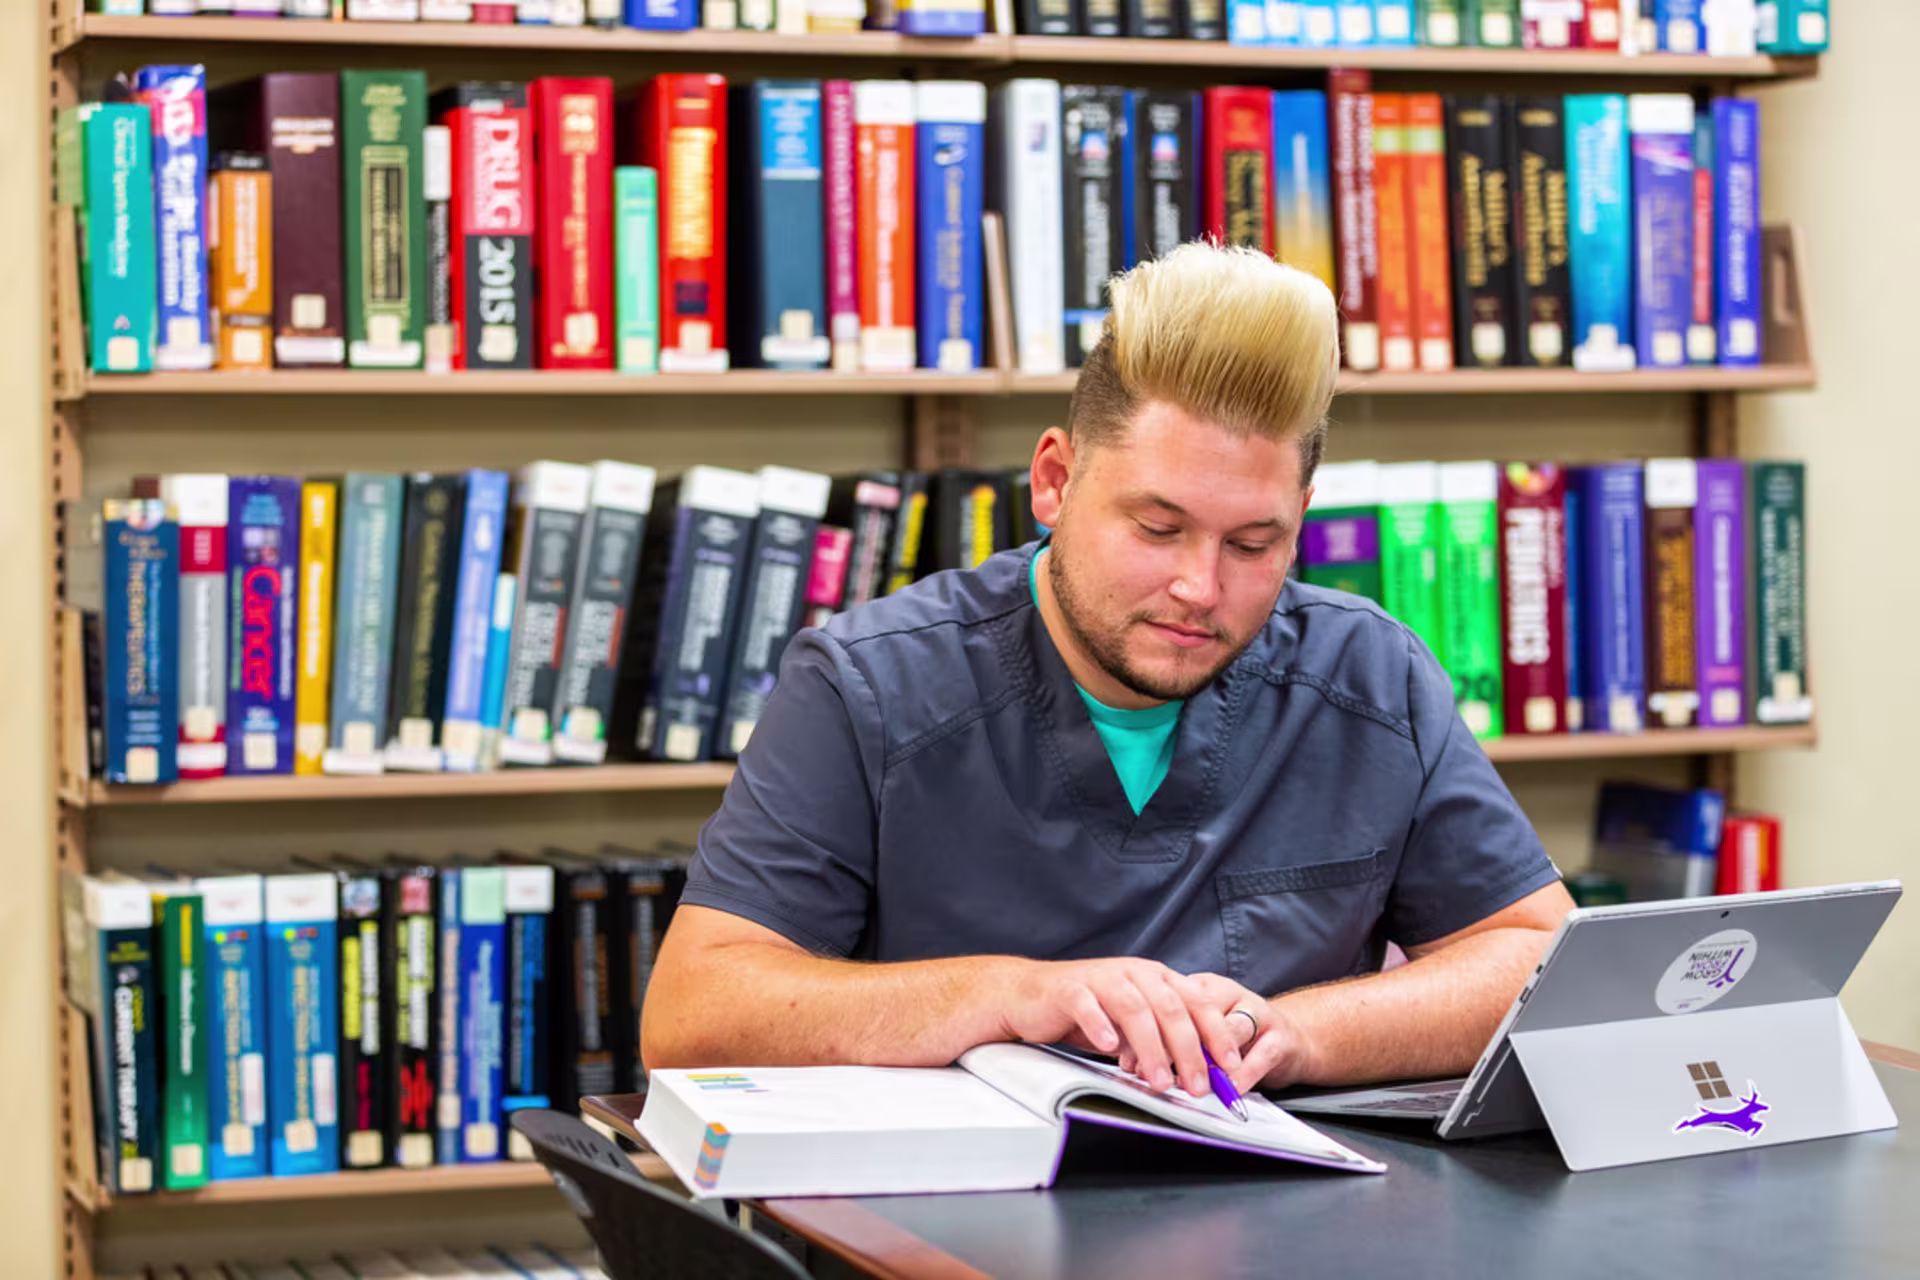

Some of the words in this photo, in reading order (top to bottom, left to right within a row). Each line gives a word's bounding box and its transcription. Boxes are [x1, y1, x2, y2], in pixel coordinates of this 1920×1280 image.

[485, 119, 521, 227] DRUG
[1460, 153, 1485, 288] Anesthesia
[1484, 171, 1508, 266] Miller's
[1520, 153, 1544, 287] Anesthesia
[1544, 171, 1567, 266] Miller's
[479, 238, 515, 323] 2015
[126, 561, 147, 695] THERAPEUTICS
[242, 565, 282, 700] Cancer
[1506, 507, 1550, 665] PEDIATRICS
[1681, 968, 1723, 981] GROW
[1689, 949, 1732, 961] WITHIN
[1691, 958, 1728, 970] FROM
